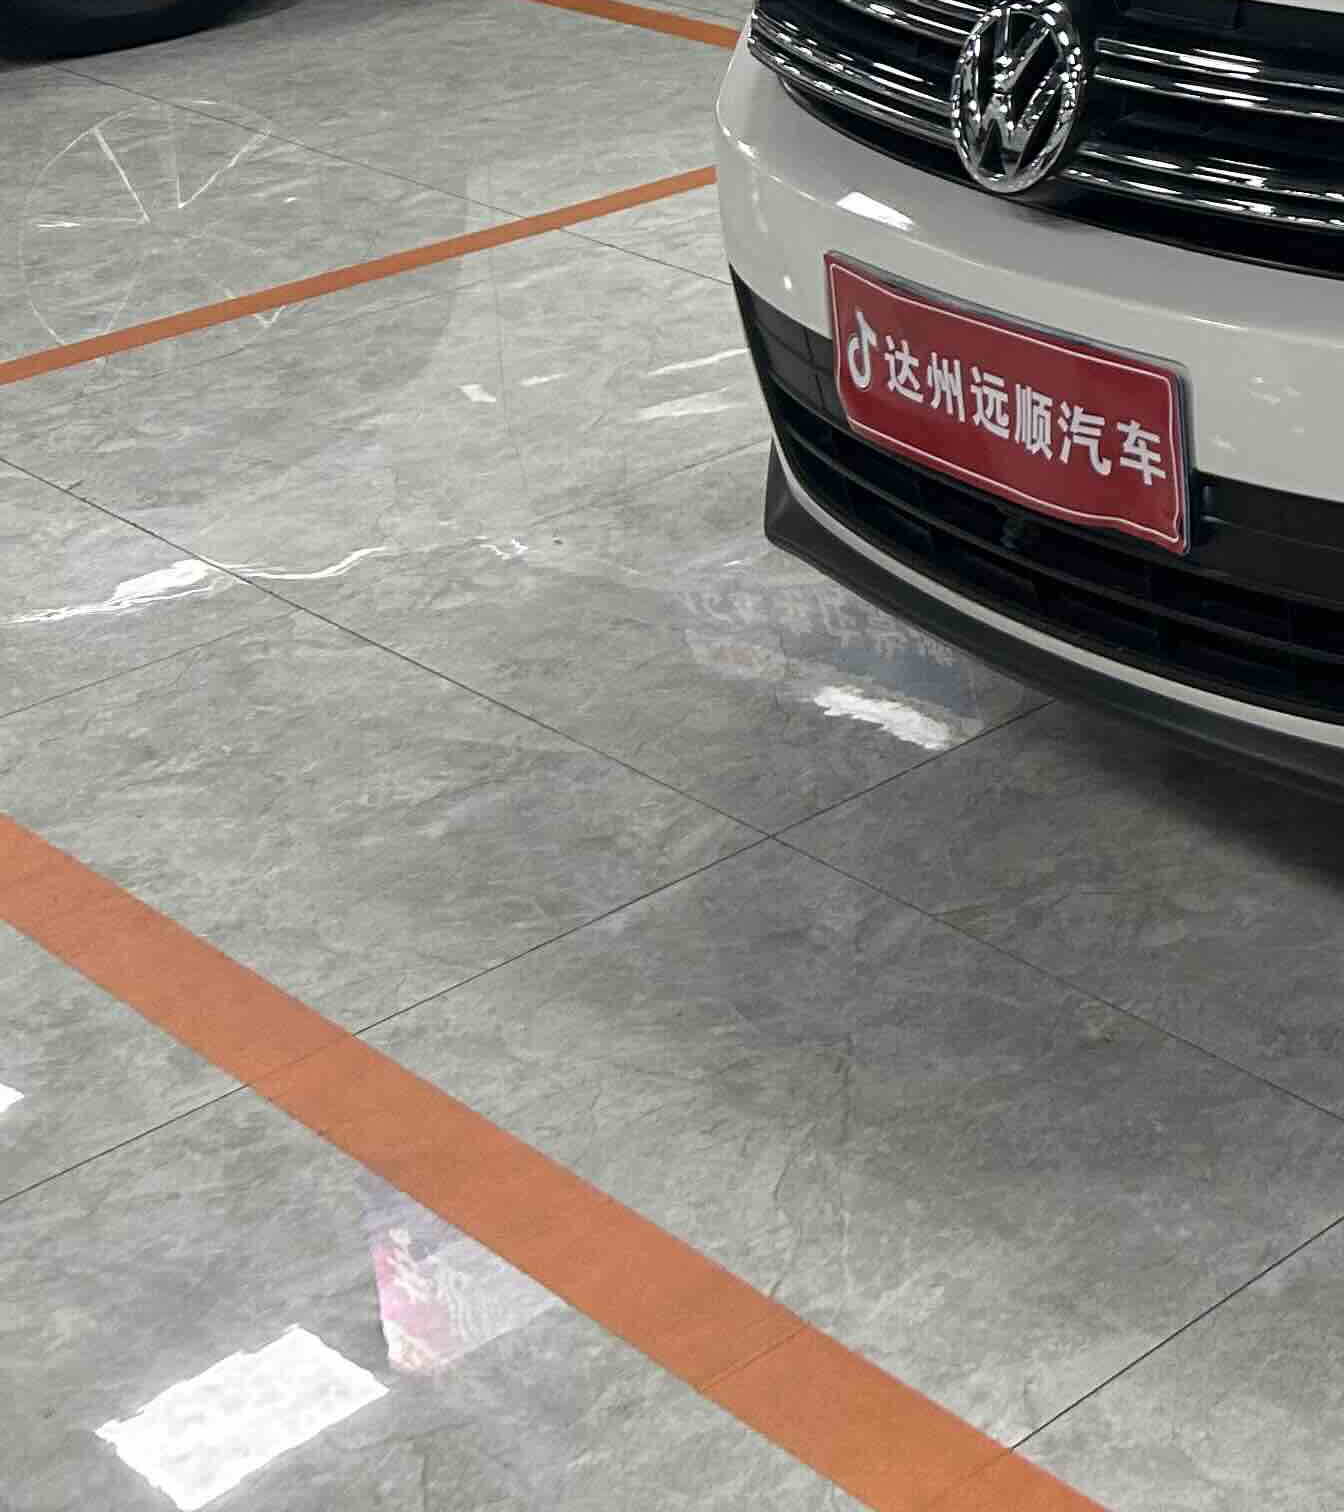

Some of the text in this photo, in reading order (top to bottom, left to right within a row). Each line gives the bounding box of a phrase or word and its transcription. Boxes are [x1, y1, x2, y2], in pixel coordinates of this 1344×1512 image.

[884, 335, 1166, 485] 达州远顺汽车
